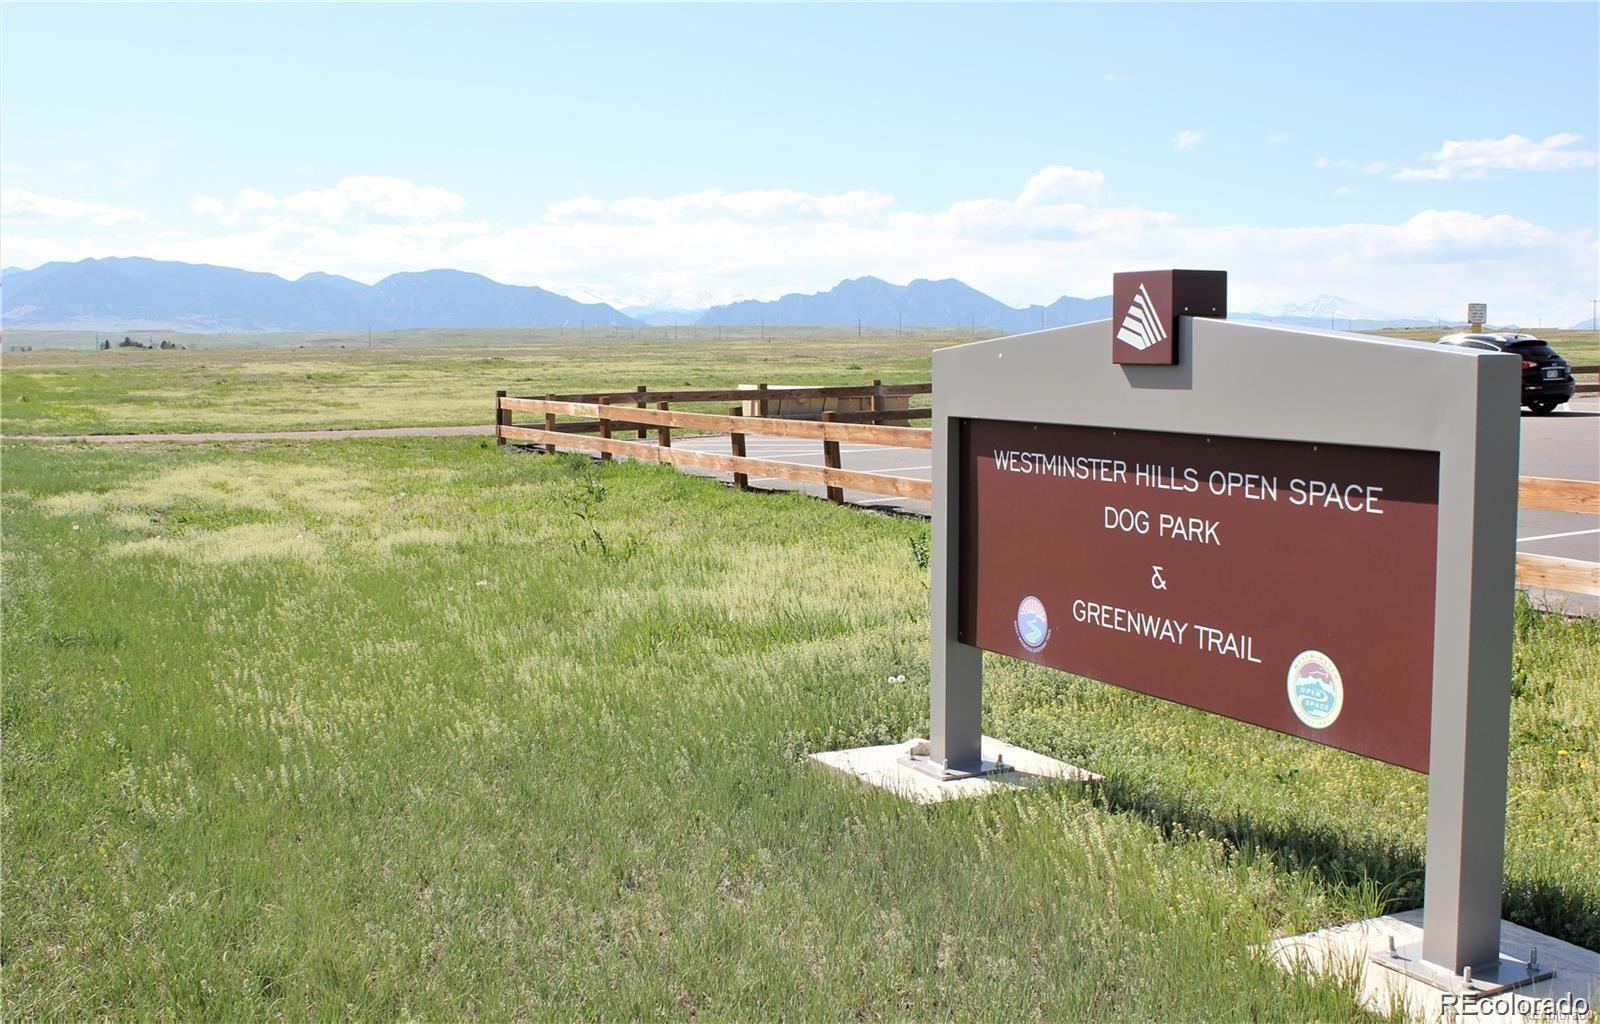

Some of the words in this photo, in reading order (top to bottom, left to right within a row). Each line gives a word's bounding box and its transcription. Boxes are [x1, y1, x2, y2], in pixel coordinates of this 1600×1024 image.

[994, 450, 1127, 483] WESTMINSTER
[1136, 464, 1199, 492] HILLS
[1209, 471, 1277, 501] OPEN
[1289, 479, 1384, 514] SPACE
[1104, 507, 1149, 534] DOG
[1160, 514, 1221, 545] PARK
[1151, 565, 1167, 590] &
[1072, 600, 1188, 644] GREENWAY
[1194, 625, 1262, 663] TRAIL
